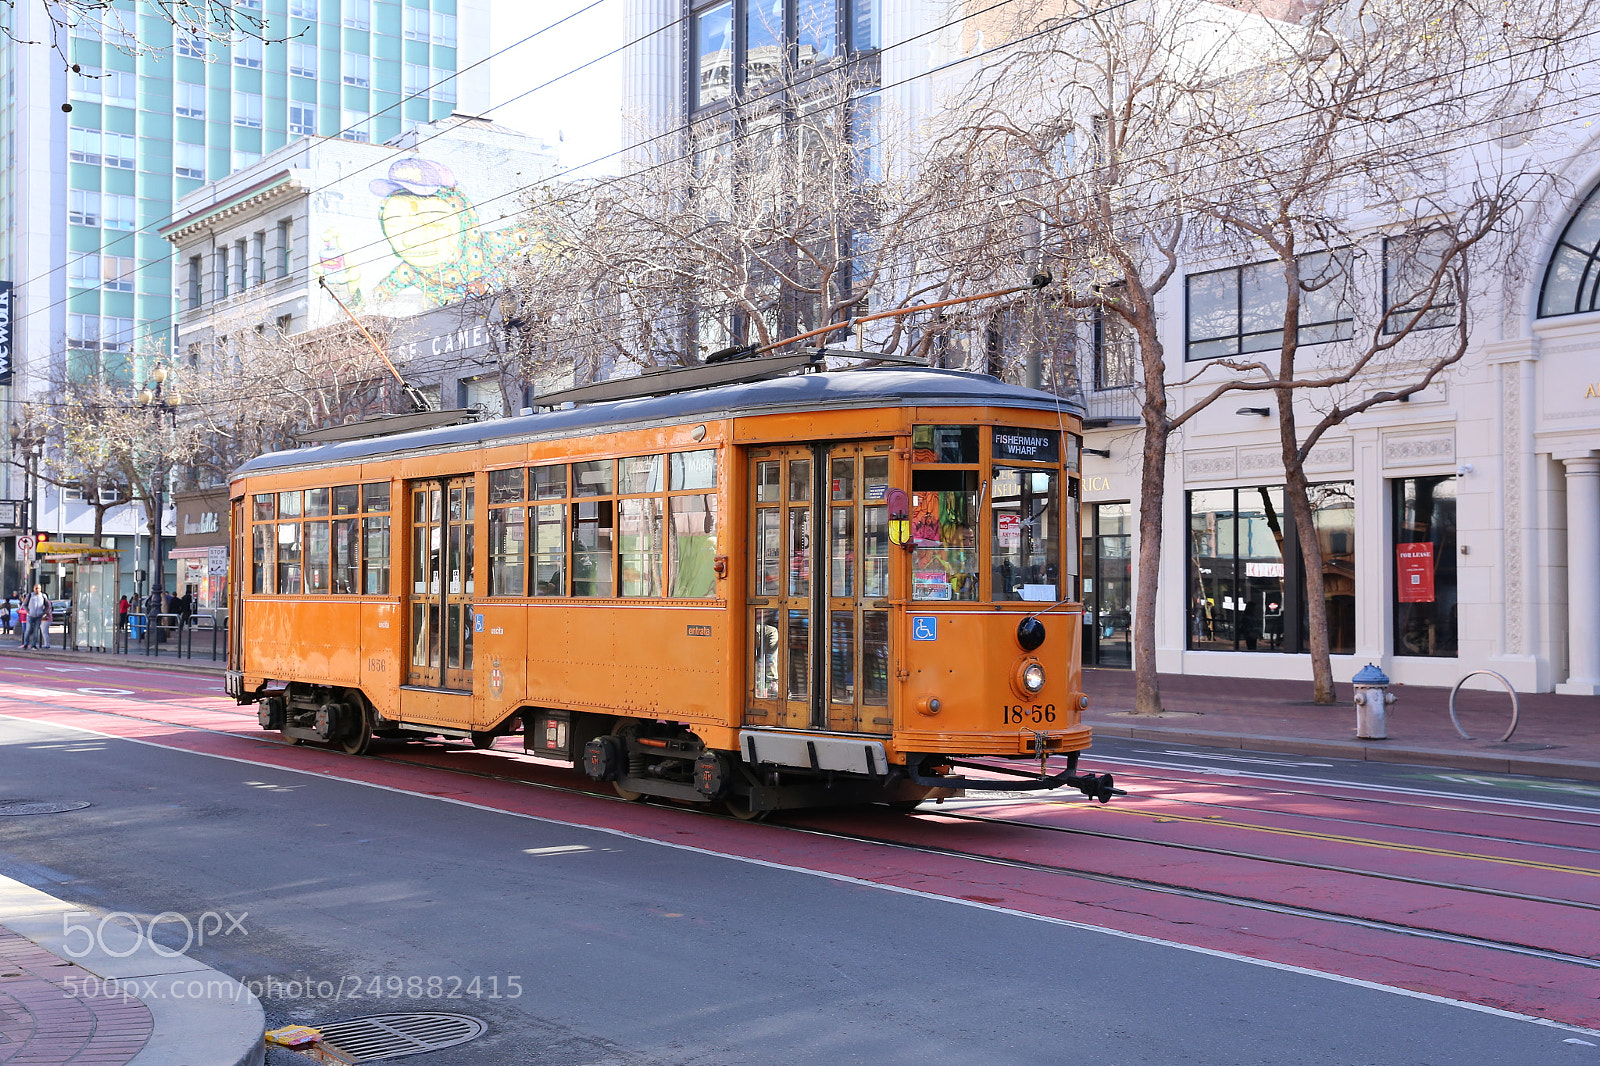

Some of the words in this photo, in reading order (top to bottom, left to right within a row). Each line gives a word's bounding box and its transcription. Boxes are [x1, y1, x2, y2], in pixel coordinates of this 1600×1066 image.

[995, 434, 1049, 447] FISHERMAN'S
[1008, 445, 1037, 455] WHARF
[688, 627, 711, 635] entrata
[368, 658, 386, 672] 1856
